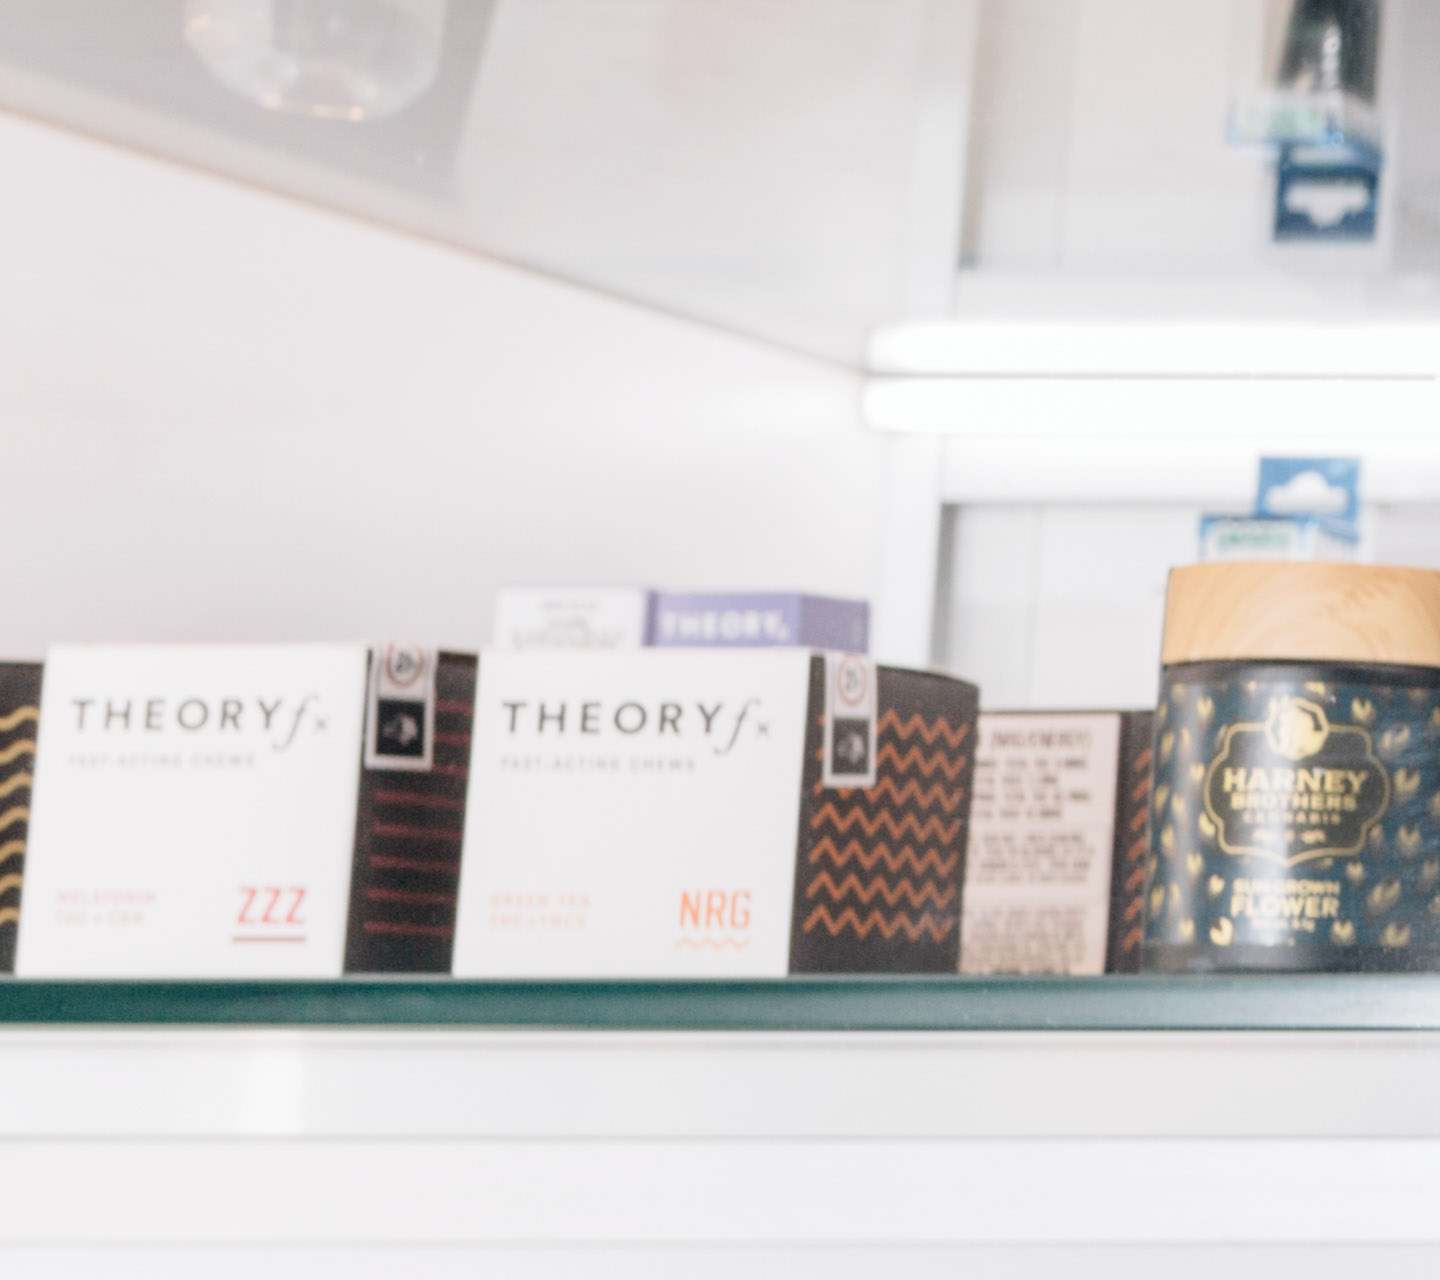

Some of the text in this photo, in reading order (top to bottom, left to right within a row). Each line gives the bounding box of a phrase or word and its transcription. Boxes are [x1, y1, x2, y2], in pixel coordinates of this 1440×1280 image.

[71, 697, 283, 732] THEORY
[501, 700, 723, 735] THEORY
[1222, 766, 1369, 794] HARNEY
[237, 887, 308, 925] ZZZ
[678, 888, 751, 928] NRG
[1230, 895, 1341, 919] FLOWER
